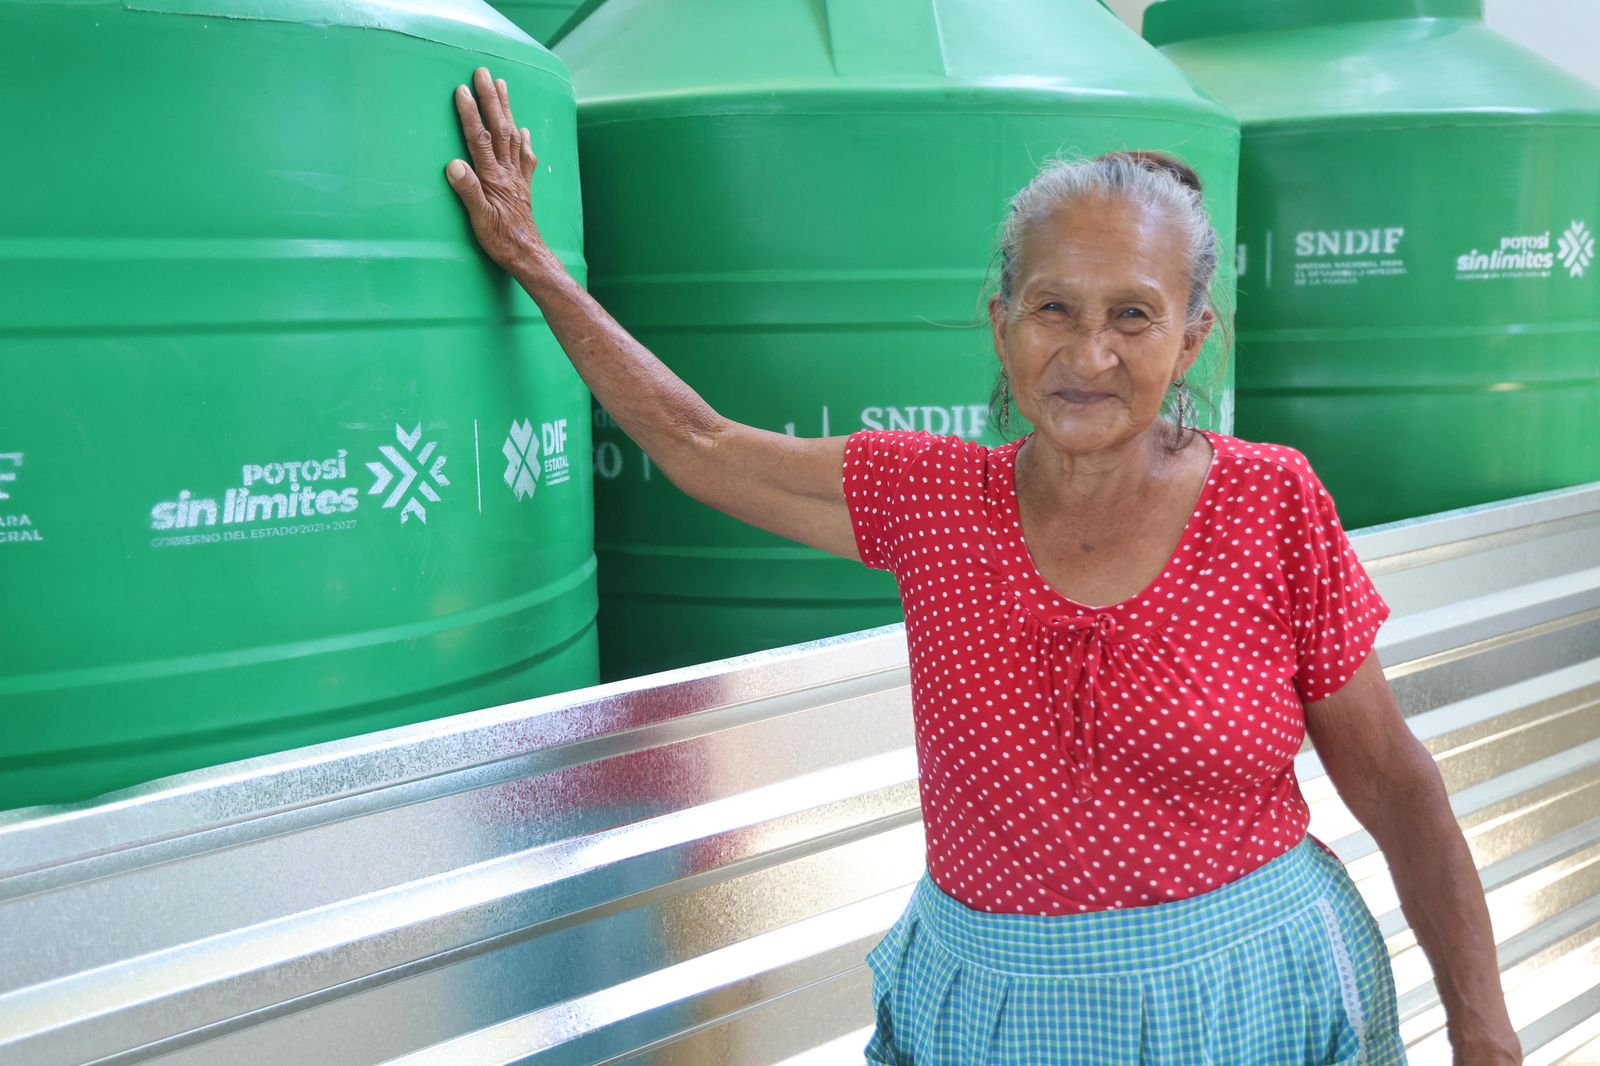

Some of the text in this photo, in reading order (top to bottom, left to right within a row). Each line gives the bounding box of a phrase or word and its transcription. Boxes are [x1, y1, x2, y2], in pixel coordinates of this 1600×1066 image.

[1295, 227, 1404, 256] SNDIF
[1457, 248, 1488, 271] sin
[861, 404, 988, 438] SNDIF
[541, 418, 567, 457] DIF
[544, 455, 569, 473] ESTATAL
[151, 489, 218, 530] sin
[223, 531, 248, 541] DEL
[250, 525, 298, 539] ESTADO
